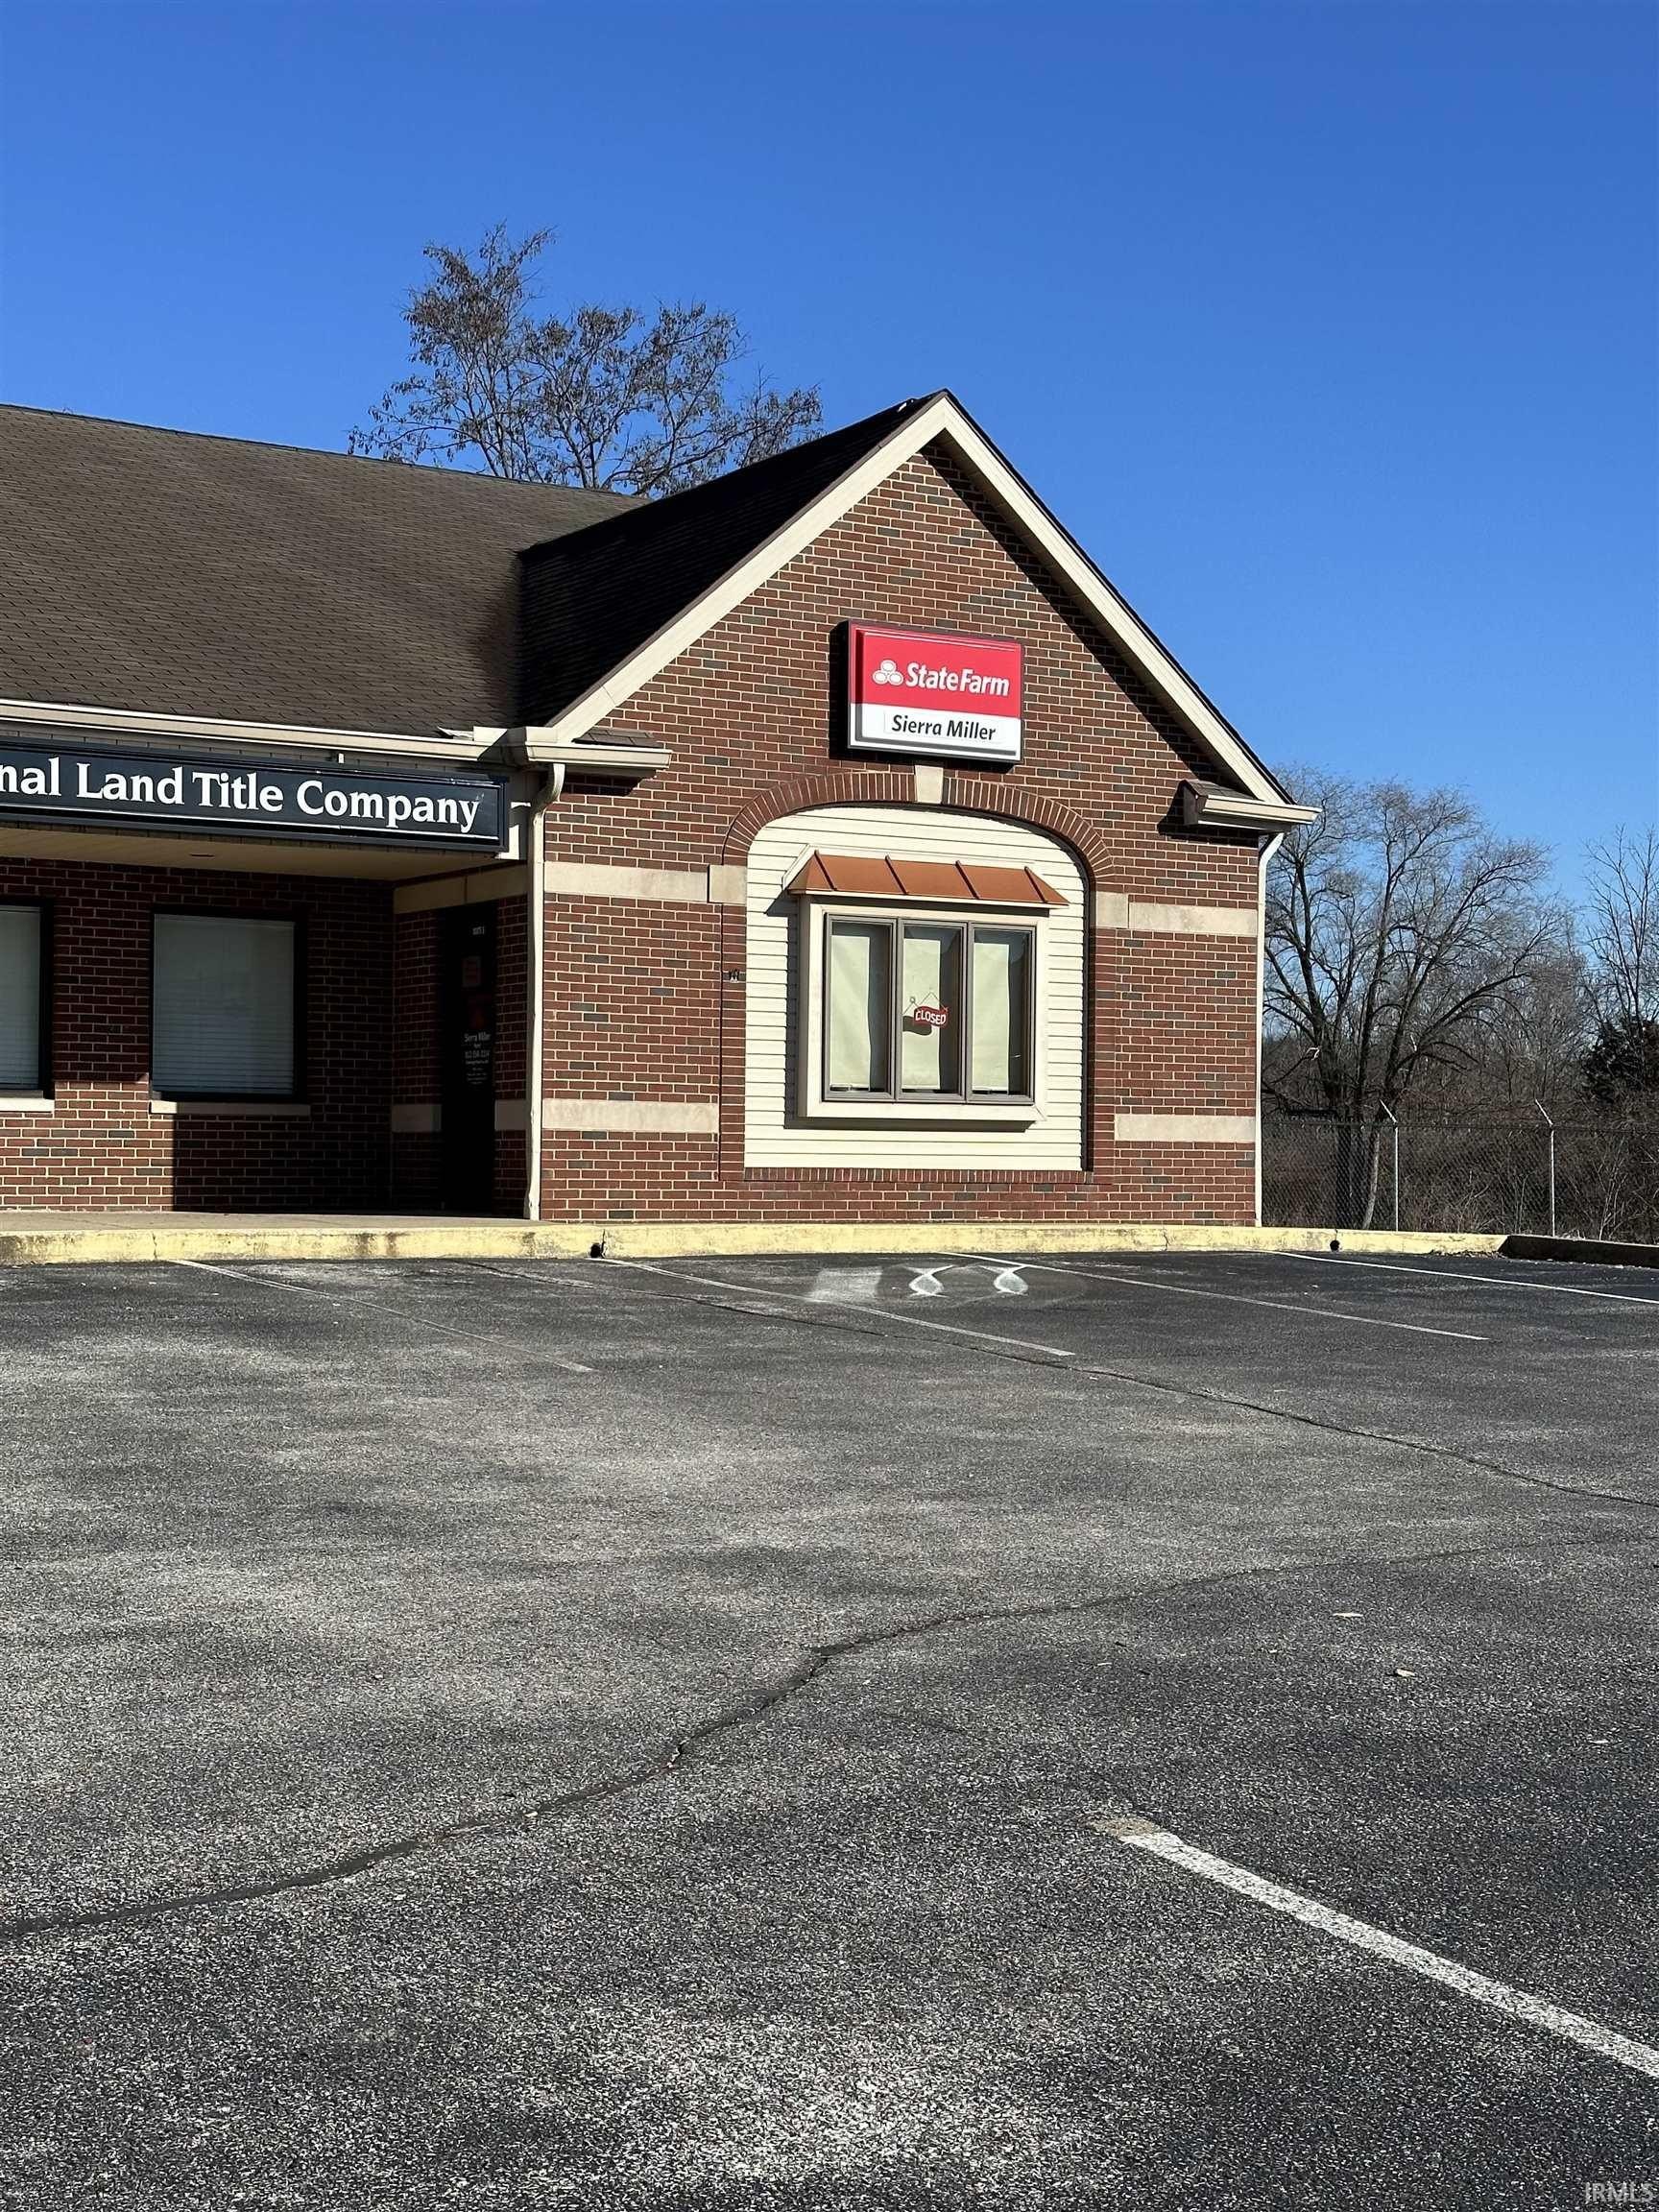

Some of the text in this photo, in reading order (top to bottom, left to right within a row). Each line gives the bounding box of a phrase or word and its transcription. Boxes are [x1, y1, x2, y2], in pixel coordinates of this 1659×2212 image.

[891, 714, 997, 741] Sierra Miller
[76, 762, 185, 805] Land
[192, 771, 284, 812] Title
[296, 780, 480, 833] Company
[915, 1010, 947, 1025] CLOSED
